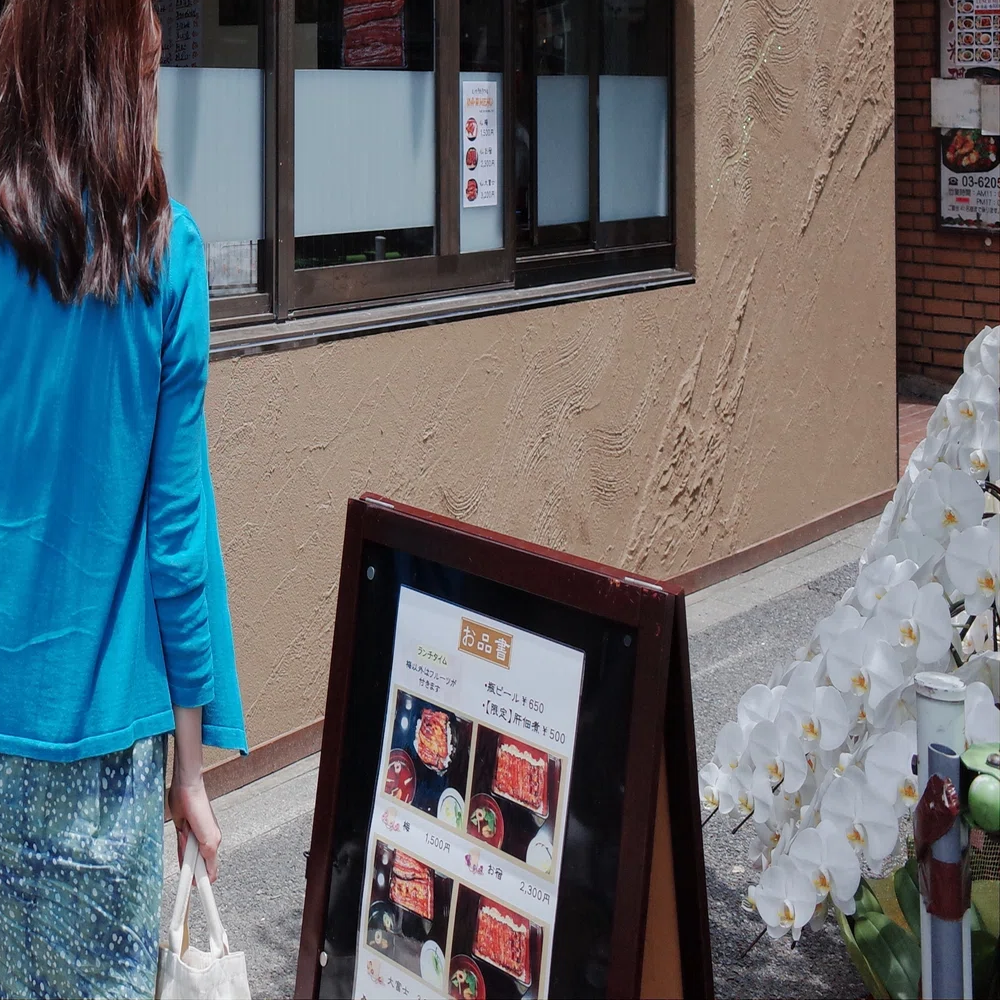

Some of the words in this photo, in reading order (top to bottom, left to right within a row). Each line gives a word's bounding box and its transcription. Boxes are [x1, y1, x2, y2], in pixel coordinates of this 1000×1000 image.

[461, 625, 511, 662] お品書
[417, 646, 448, 666] ランチタイム
[419, 678, 441, 693] 付きます
[425, 833, 451, 854] 1,500円
[520, 882, 551, 905] 2,300円
